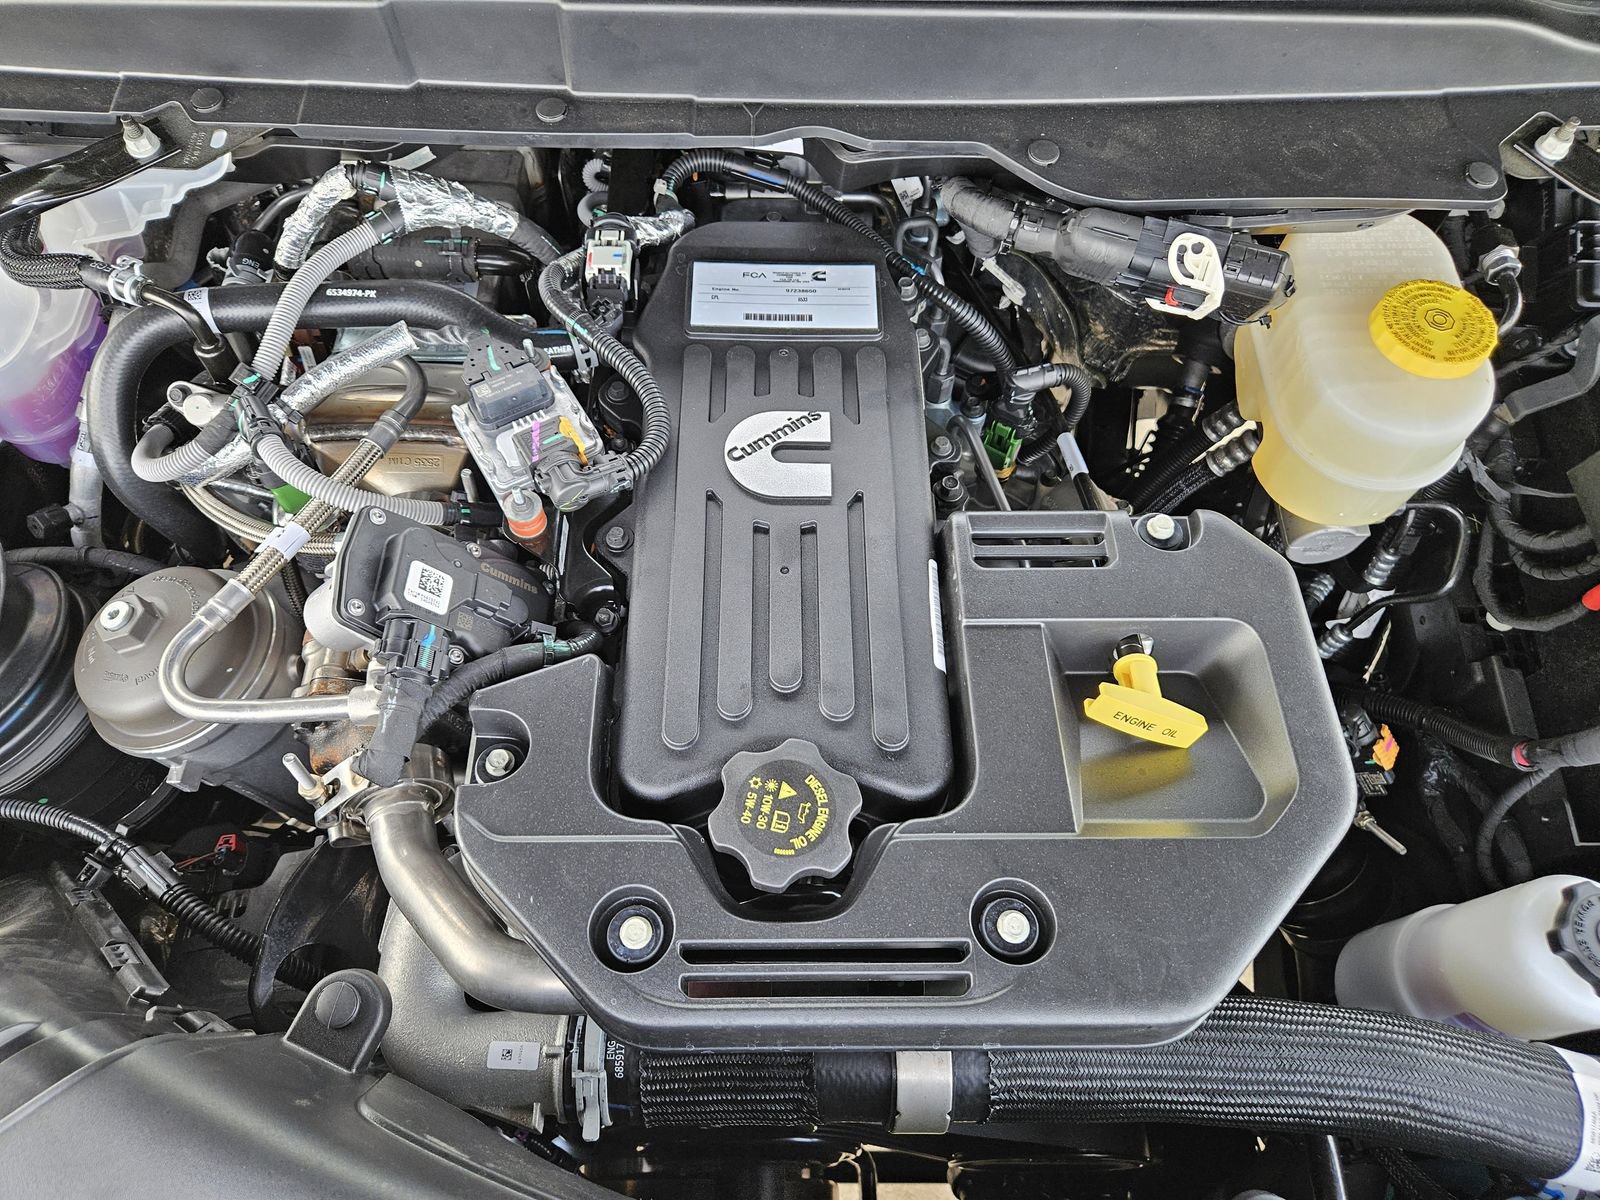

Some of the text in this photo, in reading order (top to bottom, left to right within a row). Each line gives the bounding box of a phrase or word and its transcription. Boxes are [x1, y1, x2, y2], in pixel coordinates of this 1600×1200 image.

[242, 257, 260, 269] ENG
[727, 411, 822, 462] Cummins
[480, 562, 538, 594] Cummins
[1113, 711, 1177, 738] ENGINE OIL
[740, 791, 757, 824] 5W-40
[756, 794, 773, 829] 10W-30
[790, 774, 830, 850] DIESEL ENGINE OIL
[606, 1040, 616, 1060] ENG
[614, 1043, 625, 1079] 685917
